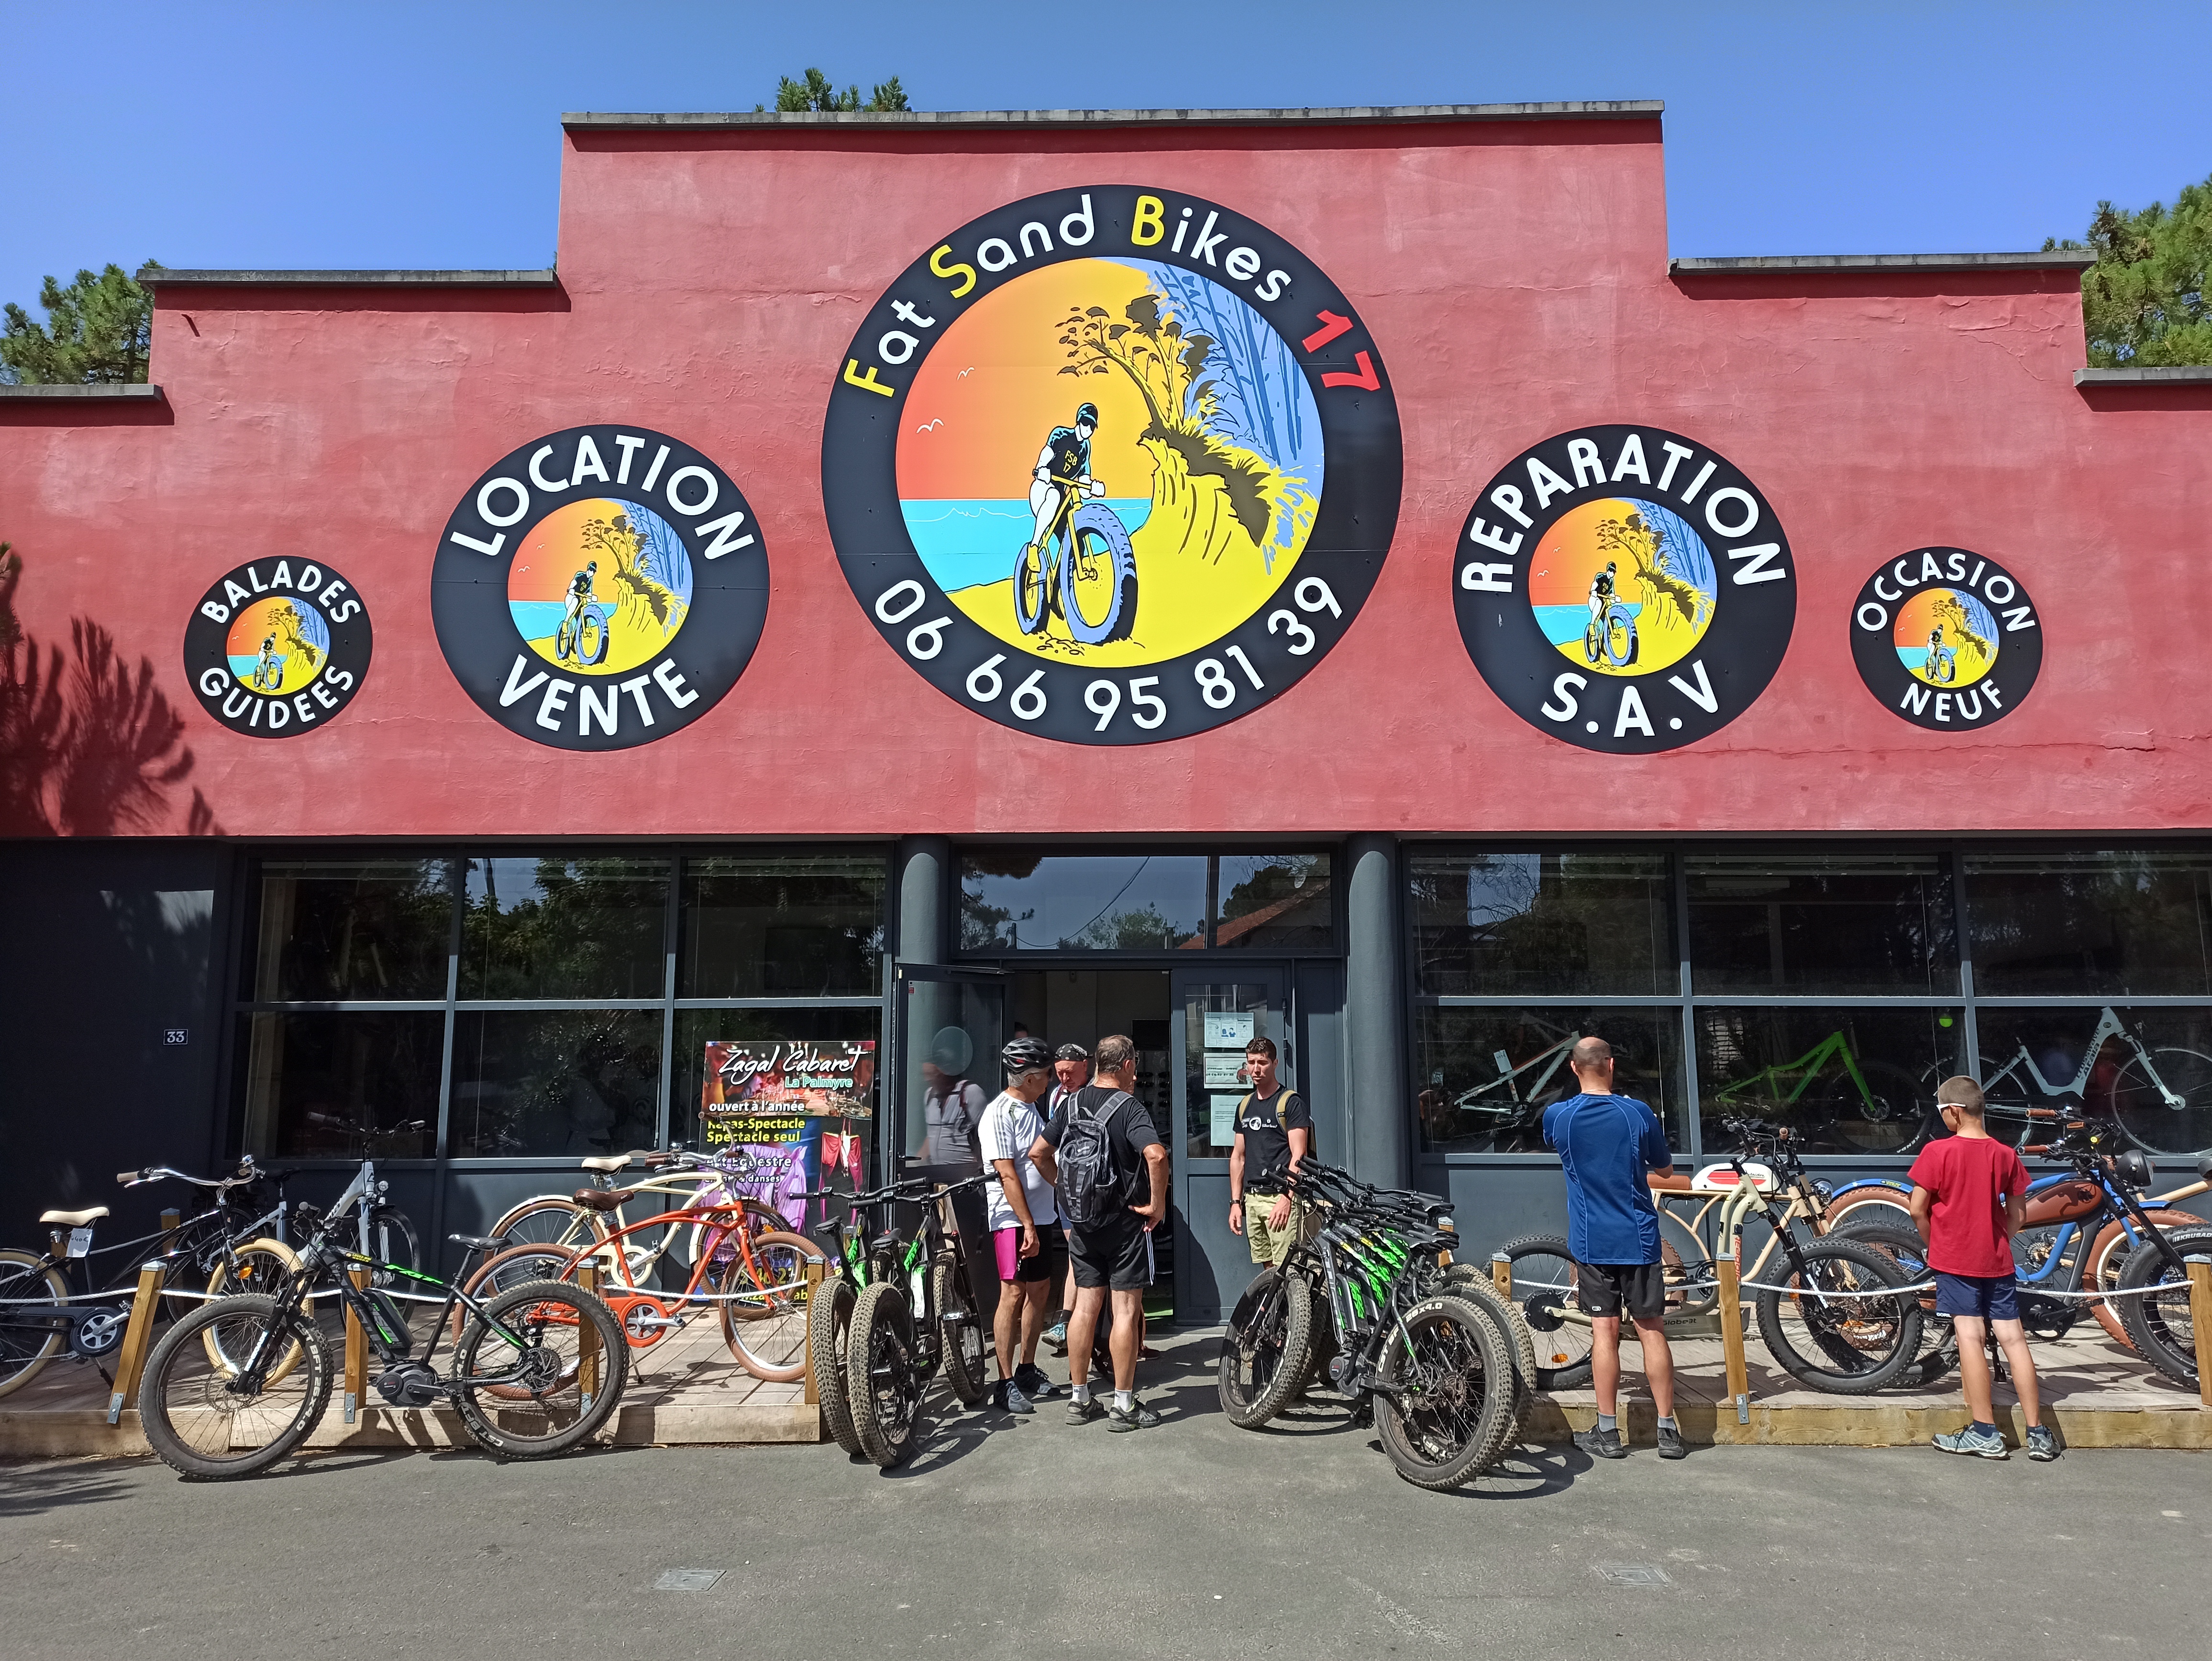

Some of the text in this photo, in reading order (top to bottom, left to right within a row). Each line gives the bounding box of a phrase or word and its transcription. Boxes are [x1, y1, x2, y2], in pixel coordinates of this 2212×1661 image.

[843, 194, 1381, 398] Fat Sand Bikes 17
[1065, 450, 1077, 465] FSB
[450, 435, 754, 560] LOCATION
[1461, 433, 1786, 594] REPARATION
[201, 560, 361, 623] BALADES
[1857, 553, 2035, 633] OCCASION
[875, 576, 1342, 731] 06 66 95 81 39
[199, 666, 354, 730] GUIDEES
[499, 654, 699, 737] VENTE
[1541, 661, 1718, 738] S.A.V
[1900, 683, 2003, 723] NEUF
[167, 1031, 185, 1043] 33
[719, 1045, 869, 1085] Zagal Cabaret
[785, 1076, 853, 1090] La Palmyre
[709, 1100, 805, 1111] ouvert à l'année
[707, 1131, 800, 1144] Spectacle seul
[748, 1174, 780, 1183] danses
[2180, 1232, 2212, 1240] KRUSAD
[293, 1321, 314, 1342] CST
[310, 1344, 322, 1373] BFT
[1378, 1325, 1400, 1373] CST BF
[461, 1405, 481, 1431] BFT
[478, 1431, 504, 1447] CST
